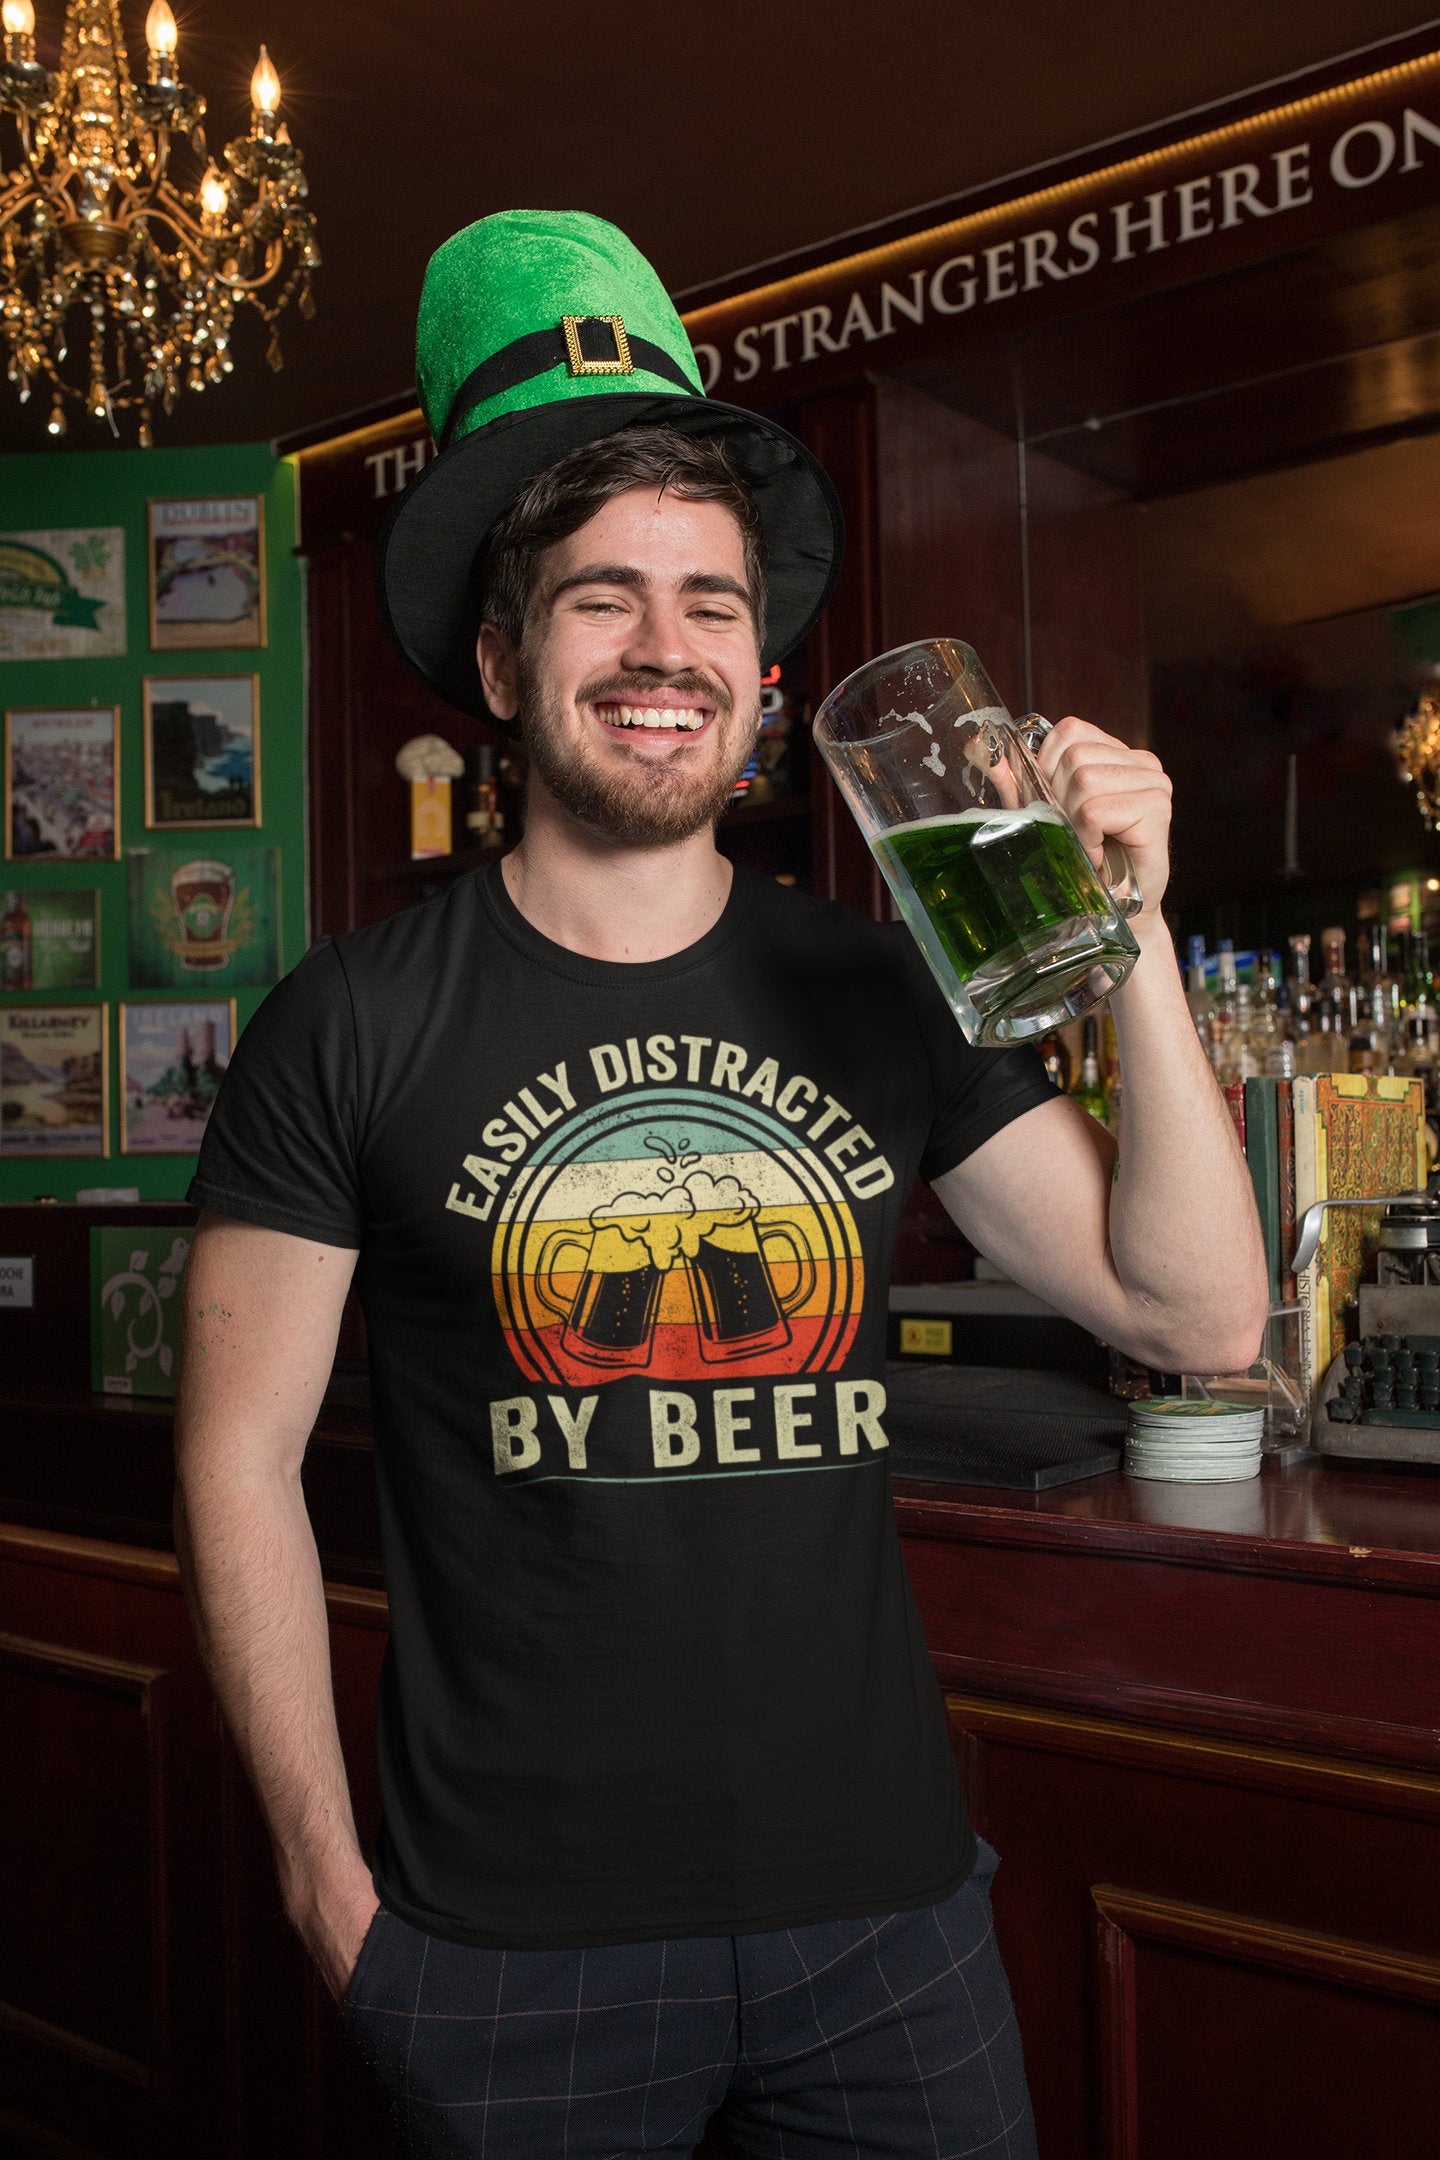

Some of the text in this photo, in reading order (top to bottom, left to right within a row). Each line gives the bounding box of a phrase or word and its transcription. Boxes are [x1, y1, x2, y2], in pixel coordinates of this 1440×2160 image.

[734, 213, 1099, 382] STRANGERS
[1110, 143, 1313, 263] HERE
[445, 1034, 896, 1222] EASILY DISTRACTED
[489, 1379, 890, 1475] BY BEER
